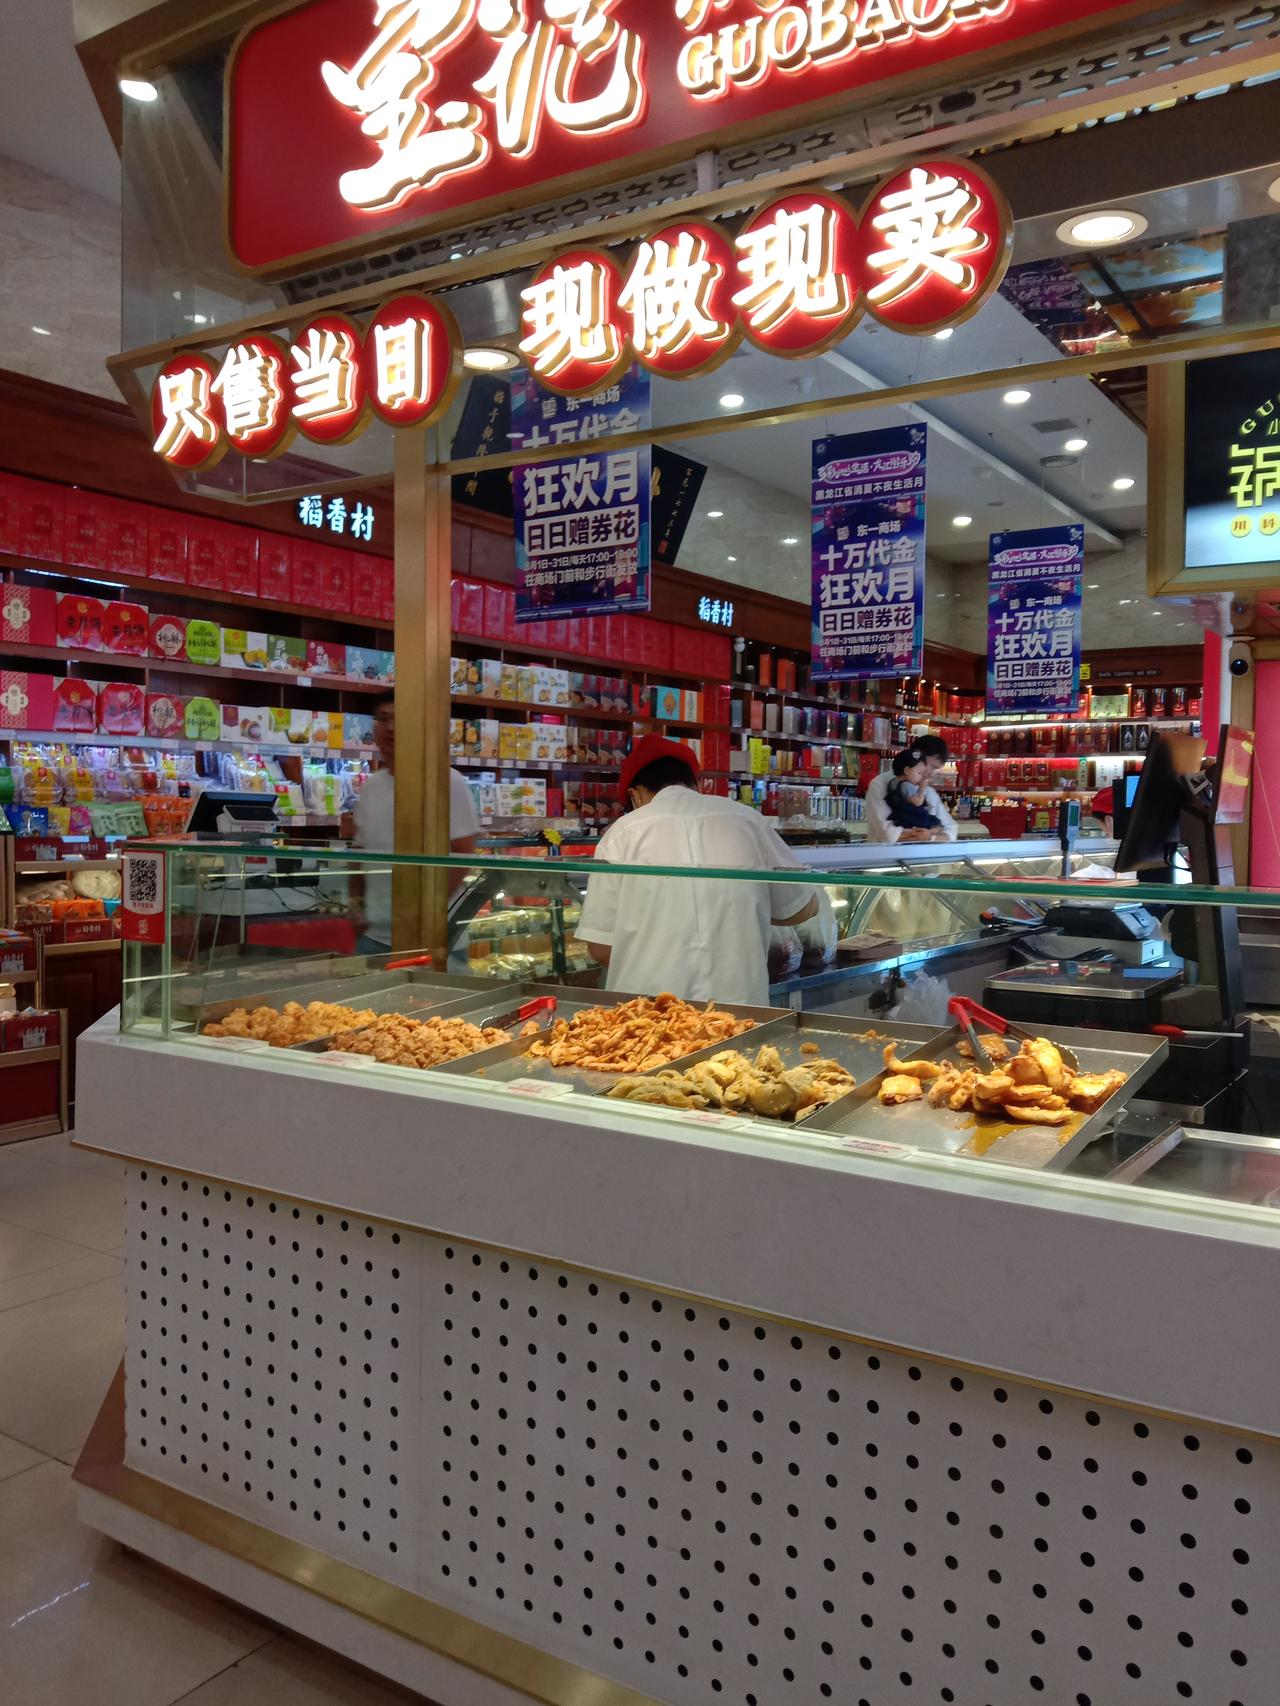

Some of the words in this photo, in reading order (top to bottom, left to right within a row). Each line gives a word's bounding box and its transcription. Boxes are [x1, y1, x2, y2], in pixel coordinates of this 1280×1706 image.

[676, 0, 1006, 98] GUOBAO
[519, 168, 992, 382] 现做现卖
[153, 318, 430, 456] 只售当日
[524, 451, 639, 516] 狂欢月
[298, 495, 374, 541] 稻香村
[528, 510, 636, 551] 日日赠券花
[819, 535, 916, 571] 十万代金
[819, 566, 914, 608] 狂欢月
[699, 596, 734, 627] 稻香村
[822, 606, 912, 632] 日日赠券花
[995, 607, 1075, 633] 十万代金
[994, 630, 1072, 660] 狂欢月
[996, 660, 1071, 679] 日日赠券花
